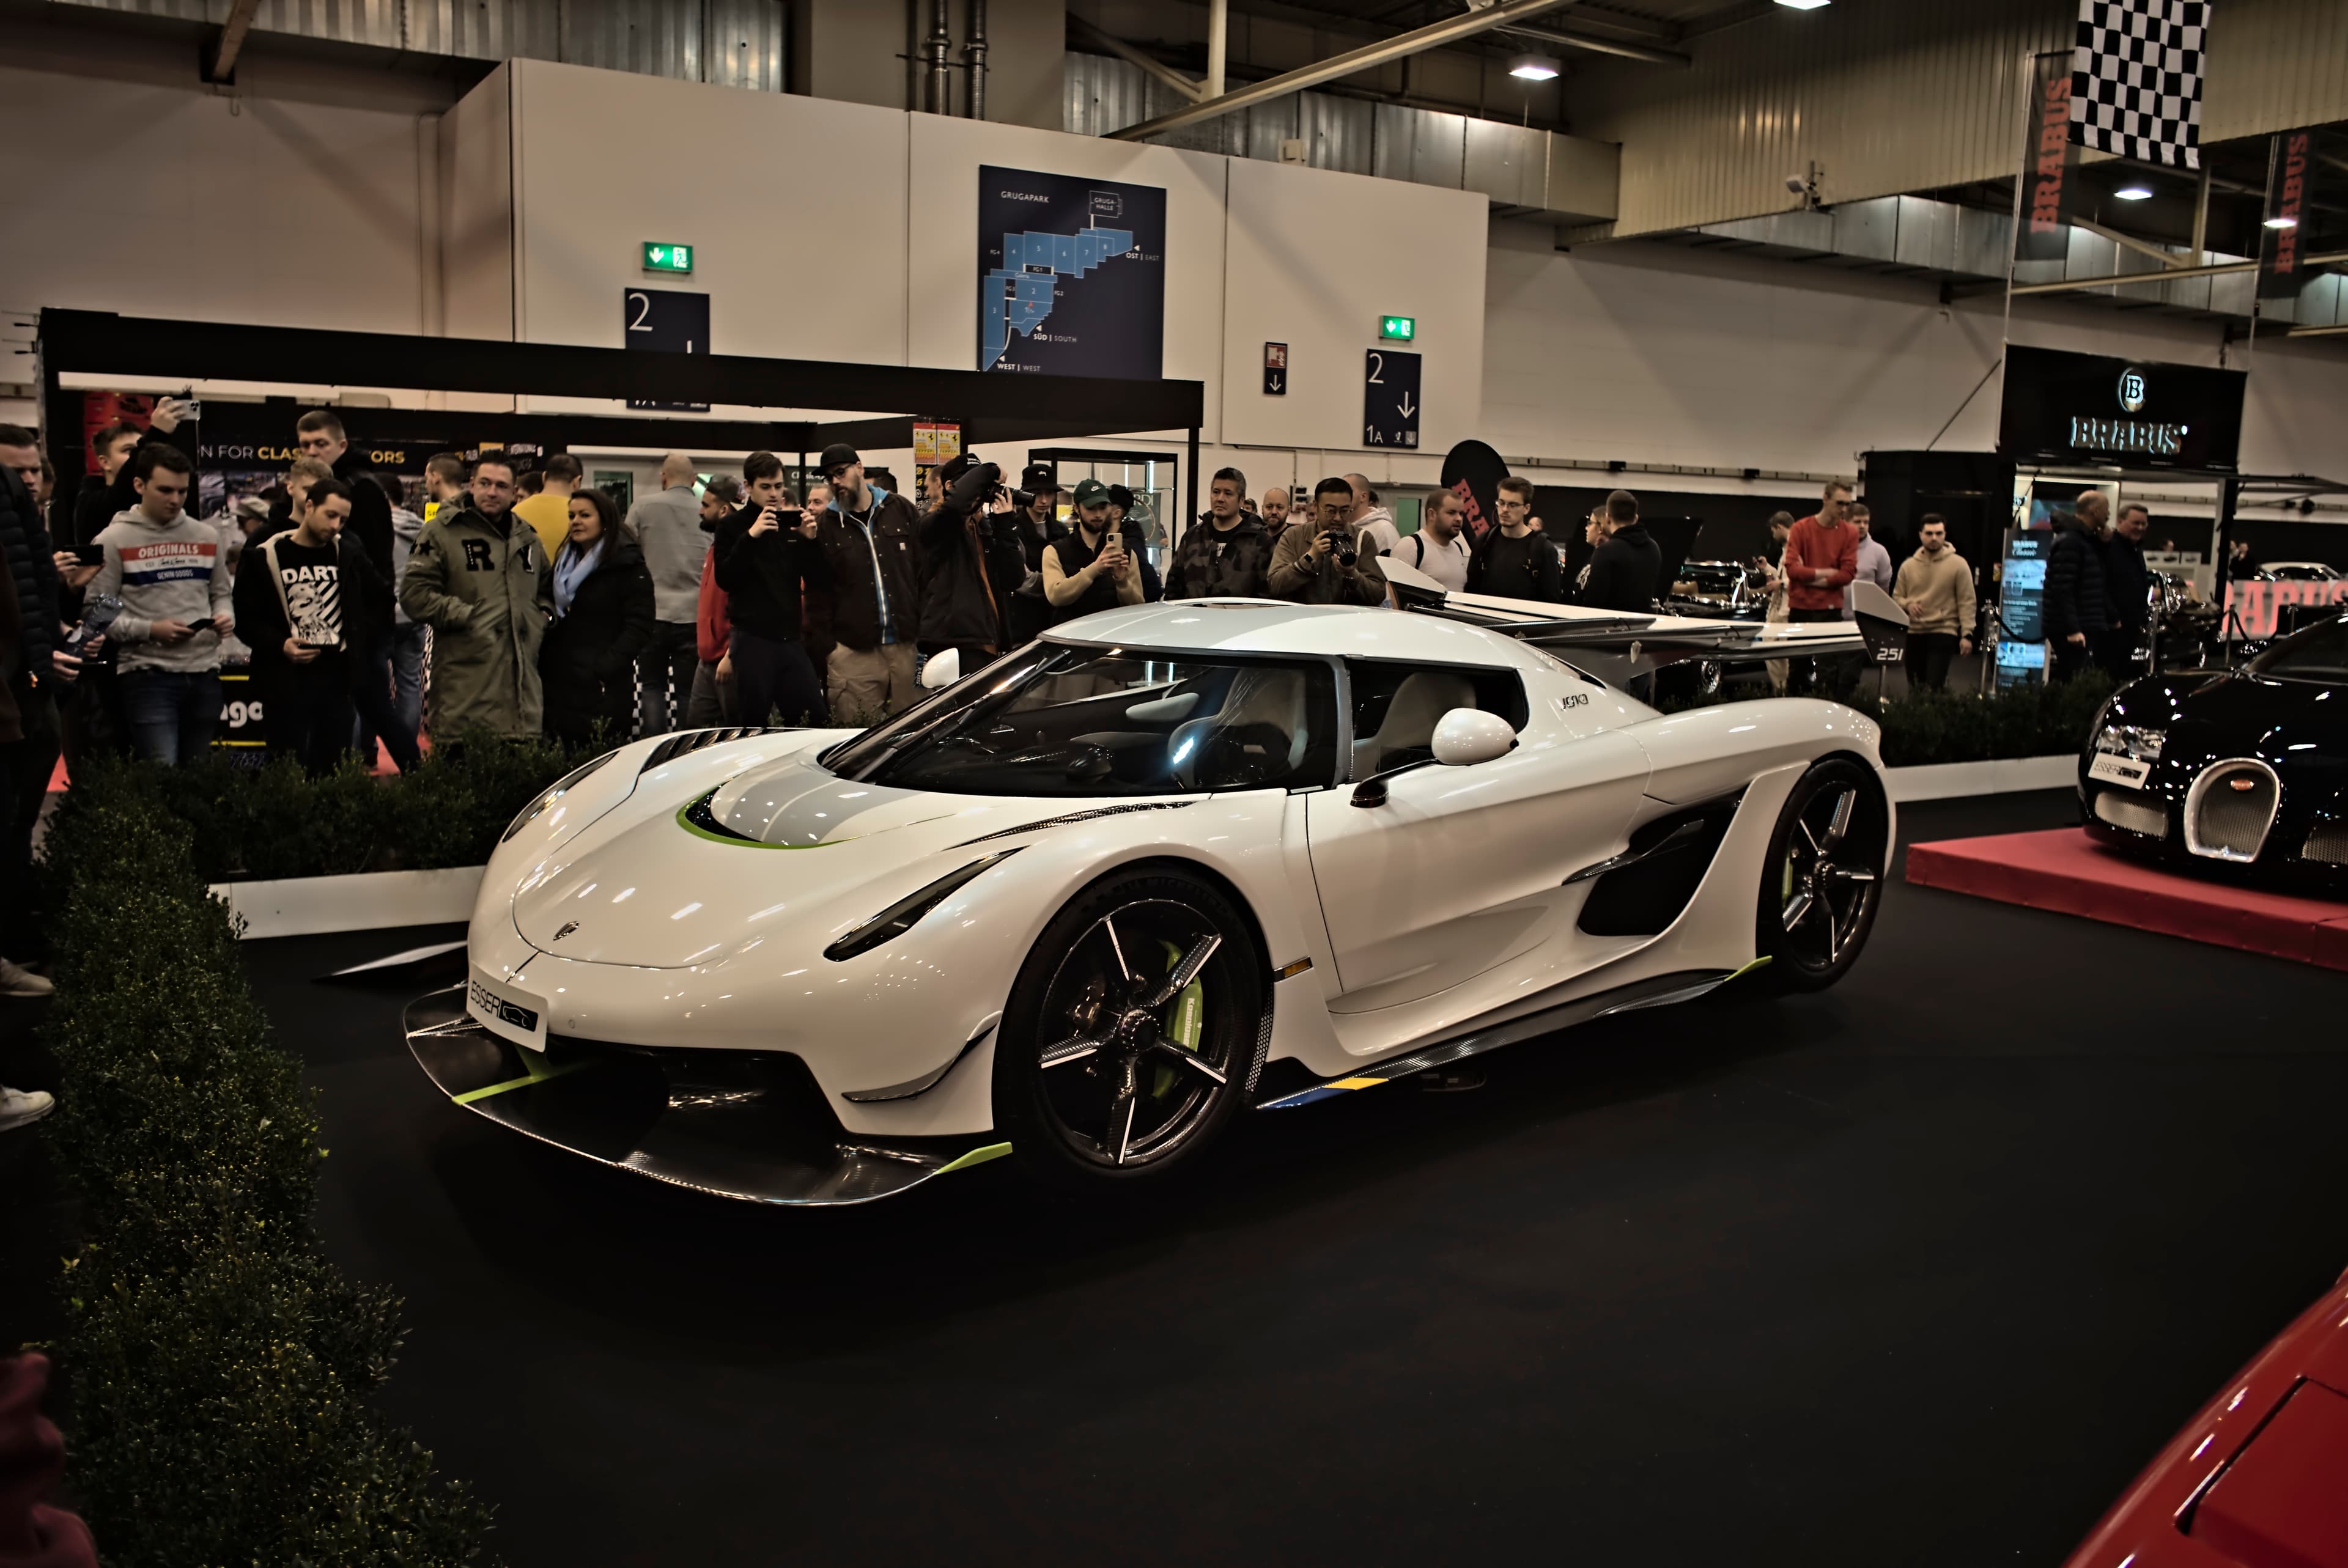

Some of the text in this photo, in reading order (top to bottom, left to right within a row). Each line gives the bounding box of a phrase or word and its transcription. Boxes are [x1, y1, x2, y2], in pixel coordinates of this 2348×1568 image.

[2030, 78, 2072, 234] BRABUS
[1000, 191, 1049, 203] GRUGAPARK
[2274, 133, 2308, 274] BRABUS
[629, 292, 653, 332] 2
[1368, 353, 1384, 384] 2
[1366, 425, 1384, 444] 1A
[2069, 415, 2182, 455] BRABUS
[218, 445, 254, 459] FOR
[369, 449, 405, 464] ORS
[138, 543, 199, 559] ORIGINALS
[462, 539, 496, 572] R
[281, 565, 339, 584] DART
[1877, 648, 1903, 661] 251
[470, 980, 501, 1018] ESSER
